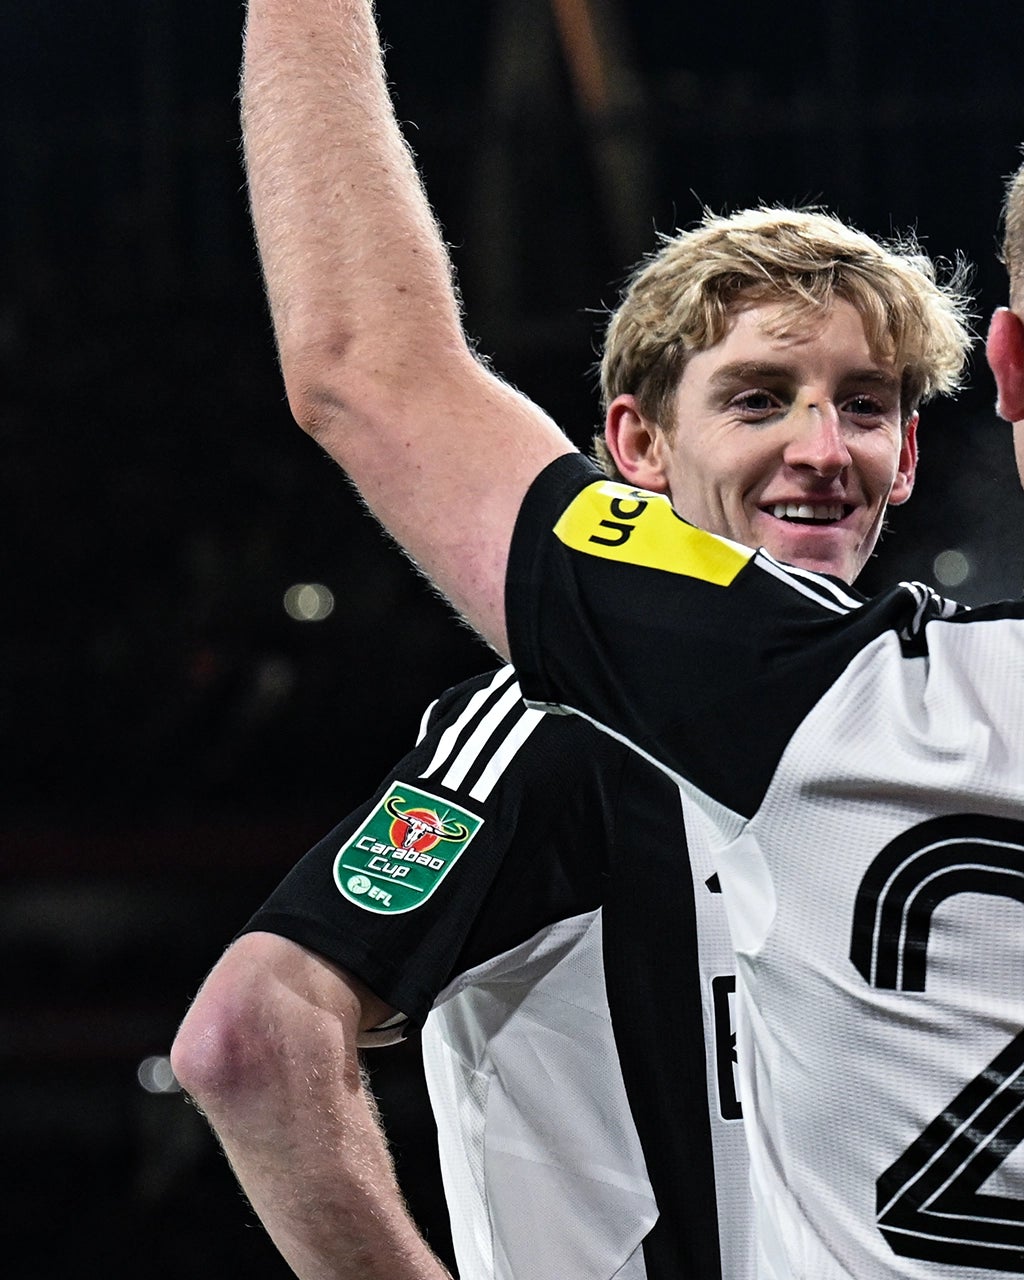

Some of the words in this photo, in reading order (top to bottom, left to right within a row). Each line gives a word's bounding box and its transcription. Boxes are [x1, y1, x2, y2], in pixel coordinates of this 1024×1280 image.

[355, 836, 445, 871] Carabao
[367, 856, 411, 878] Cup
[367, 885, 393, 907] EFL
